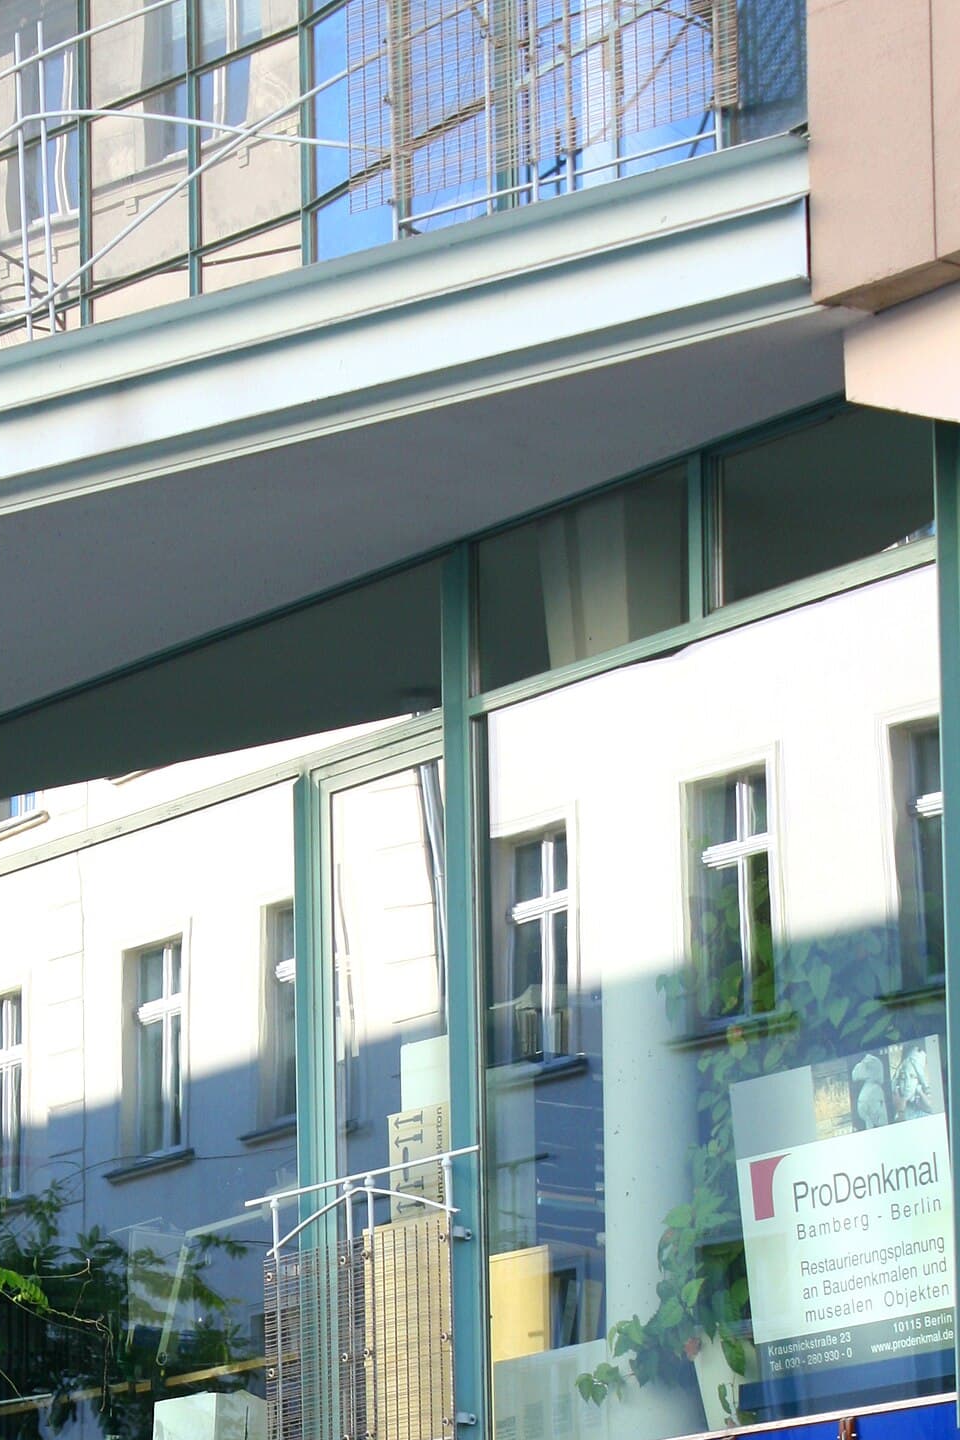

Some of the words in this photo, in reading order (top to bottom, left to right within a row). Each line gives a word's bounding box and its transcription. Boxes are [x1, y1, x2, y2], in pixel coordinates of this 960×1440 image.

[793, 1152, 939, 1213] ProDenkmal
[797, 1214, 869, 1240] Bamberg
[891, 1197, 942, 1220] Berlin
[800, 1236, 945, 1277] Restaurierungsplanung
[803, 1286, 818, 1300] an
[823, 1266, 918, 1296] Baudenkmalen
[923, 1257, 947, 1277] und
[805, 1298, 873, 1323] musealen
[884, 1283, 950, 1308] Objekten
[893, 1318, 921, 1333] 10115
[925, 1313, 953, 1328] Berlin
[768, 1334, 837, 1357] Krausnickstraße
[840, 1332, 852, 1343] 23
[847, 1348, 853, 1359] 0
[871, 1329, 954, 1353] www.prodenkmal.de
